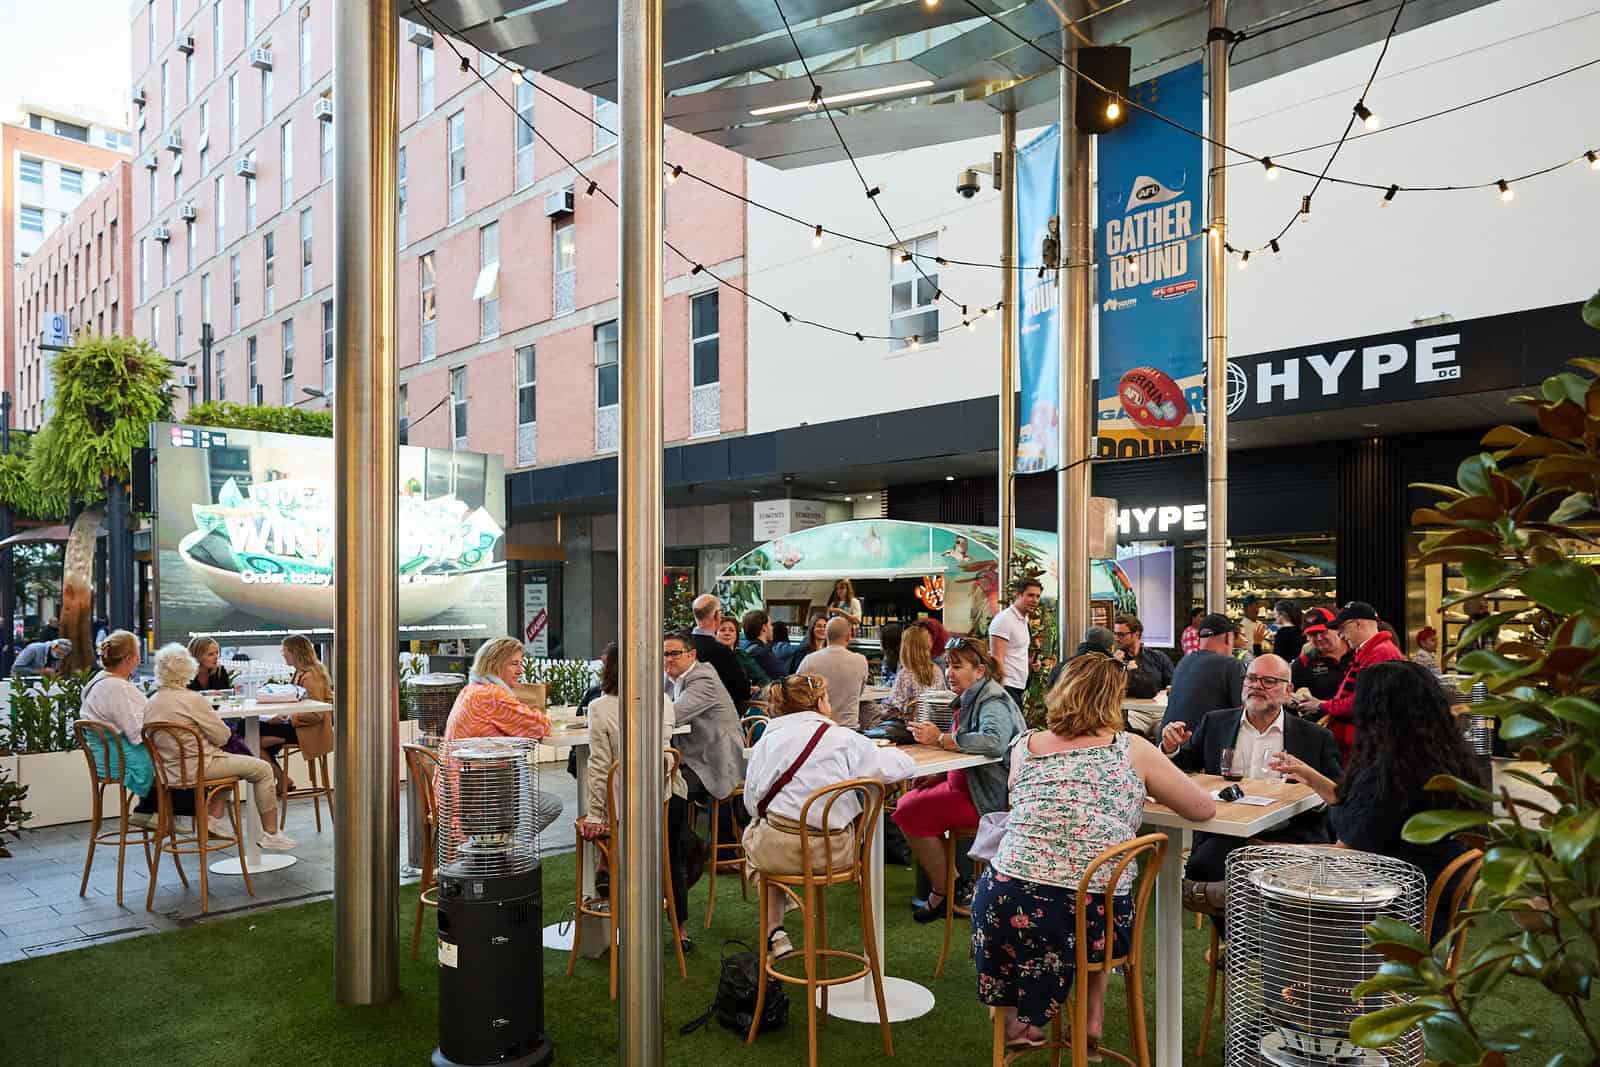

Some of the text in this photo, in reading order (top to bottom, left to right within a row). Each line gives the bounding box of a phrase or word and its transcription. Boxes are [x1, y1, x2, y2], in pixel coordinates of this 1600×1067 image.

[1138, 186, 1158, 199] AFL
[1106, 200, 1192, 256] GATHER
[1110, 240, 1188, 292] ROUND
[1257, 333, 1461, 404] HYPE
[1438, 368, 1458, 378] DC
[1124, 387, 1143, 406] AFL
[1116, 504, 1207, 534] HYPE
